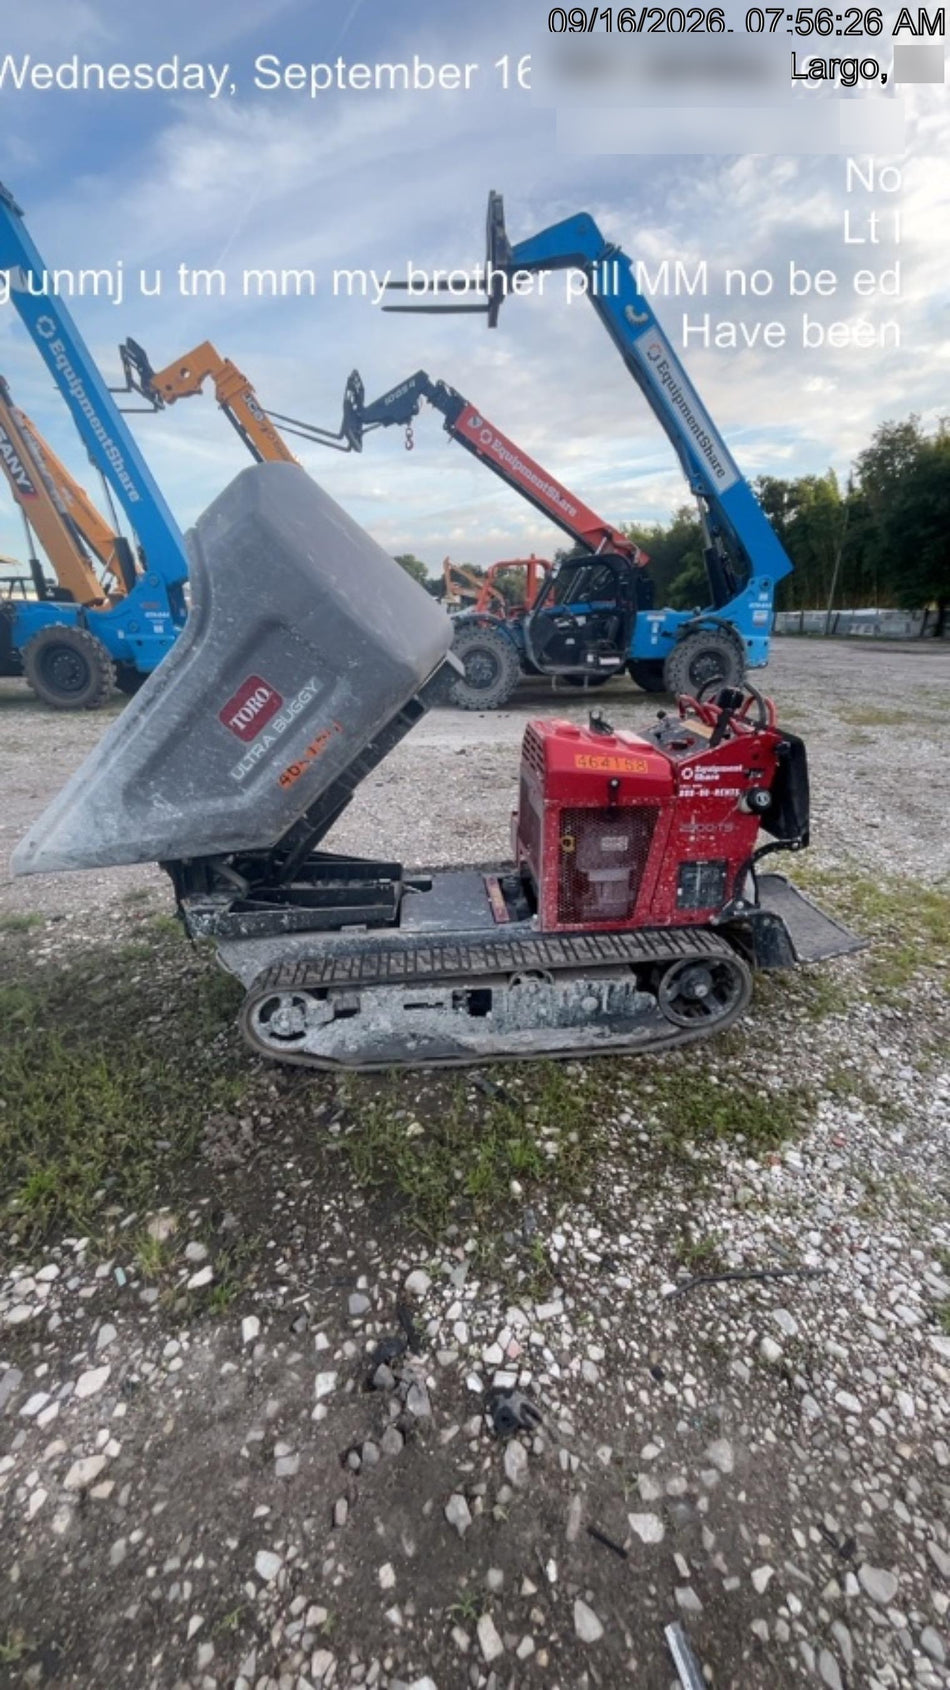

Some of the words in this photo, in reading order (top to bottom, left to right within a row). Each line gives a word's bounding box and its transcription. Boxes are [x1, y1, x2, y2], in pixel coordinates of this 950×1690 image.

[49, 337, 140, 502] EquipmentShare
[656, 359, 726, 480] EquipmentShare
[492, 437, 577, 517] EquipmentShare
[229, 686, 272, 731] TORO
[230, 734, 277, 780] ULTRA
[271, 676, 321, 733] BUGGY
